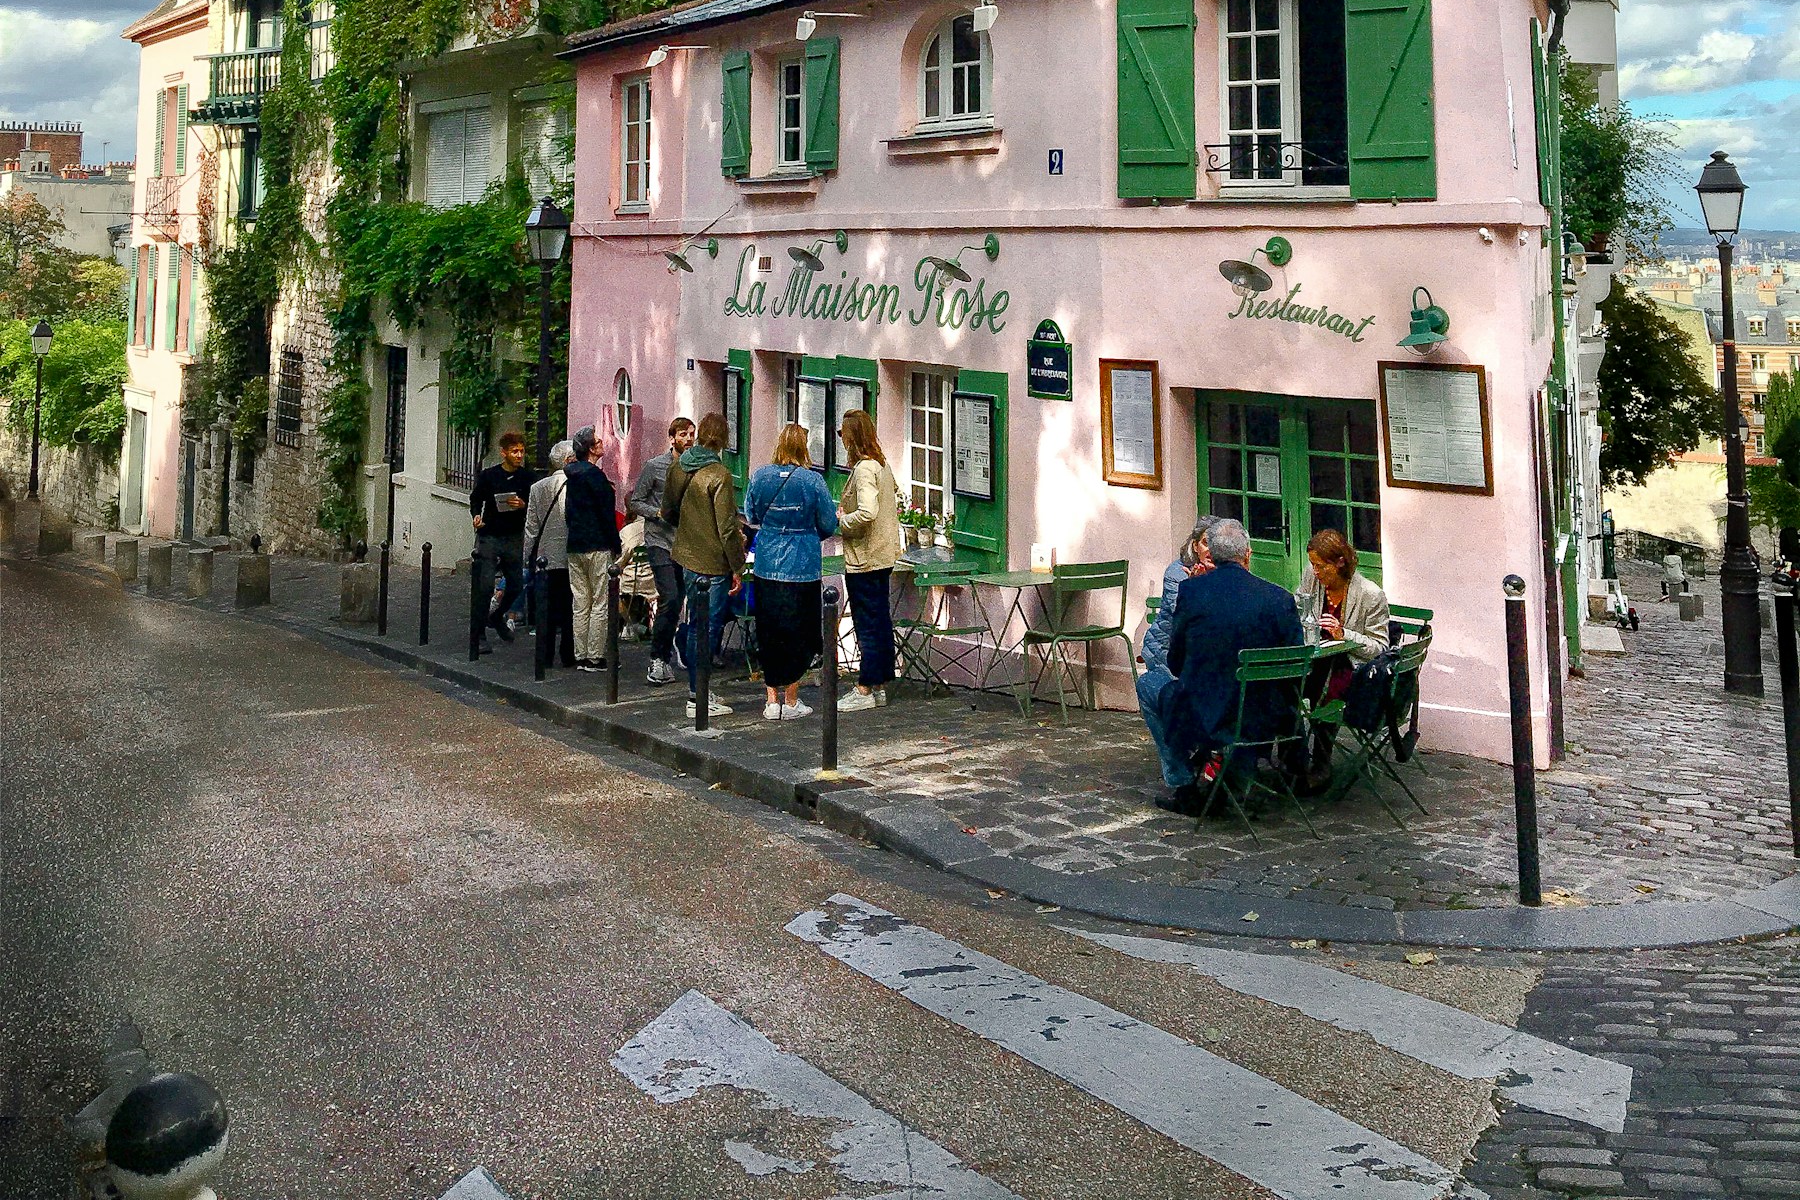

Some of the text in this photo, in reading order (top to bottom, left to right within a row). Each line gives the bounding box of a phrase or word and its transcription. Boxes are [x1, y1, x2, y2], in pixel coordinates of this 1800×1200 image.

[1052, 151, 1060, 174] 2
[724, 243, 1010, 335] La Maison Rose
[1228, 283, 1376, 343] Restaurant
